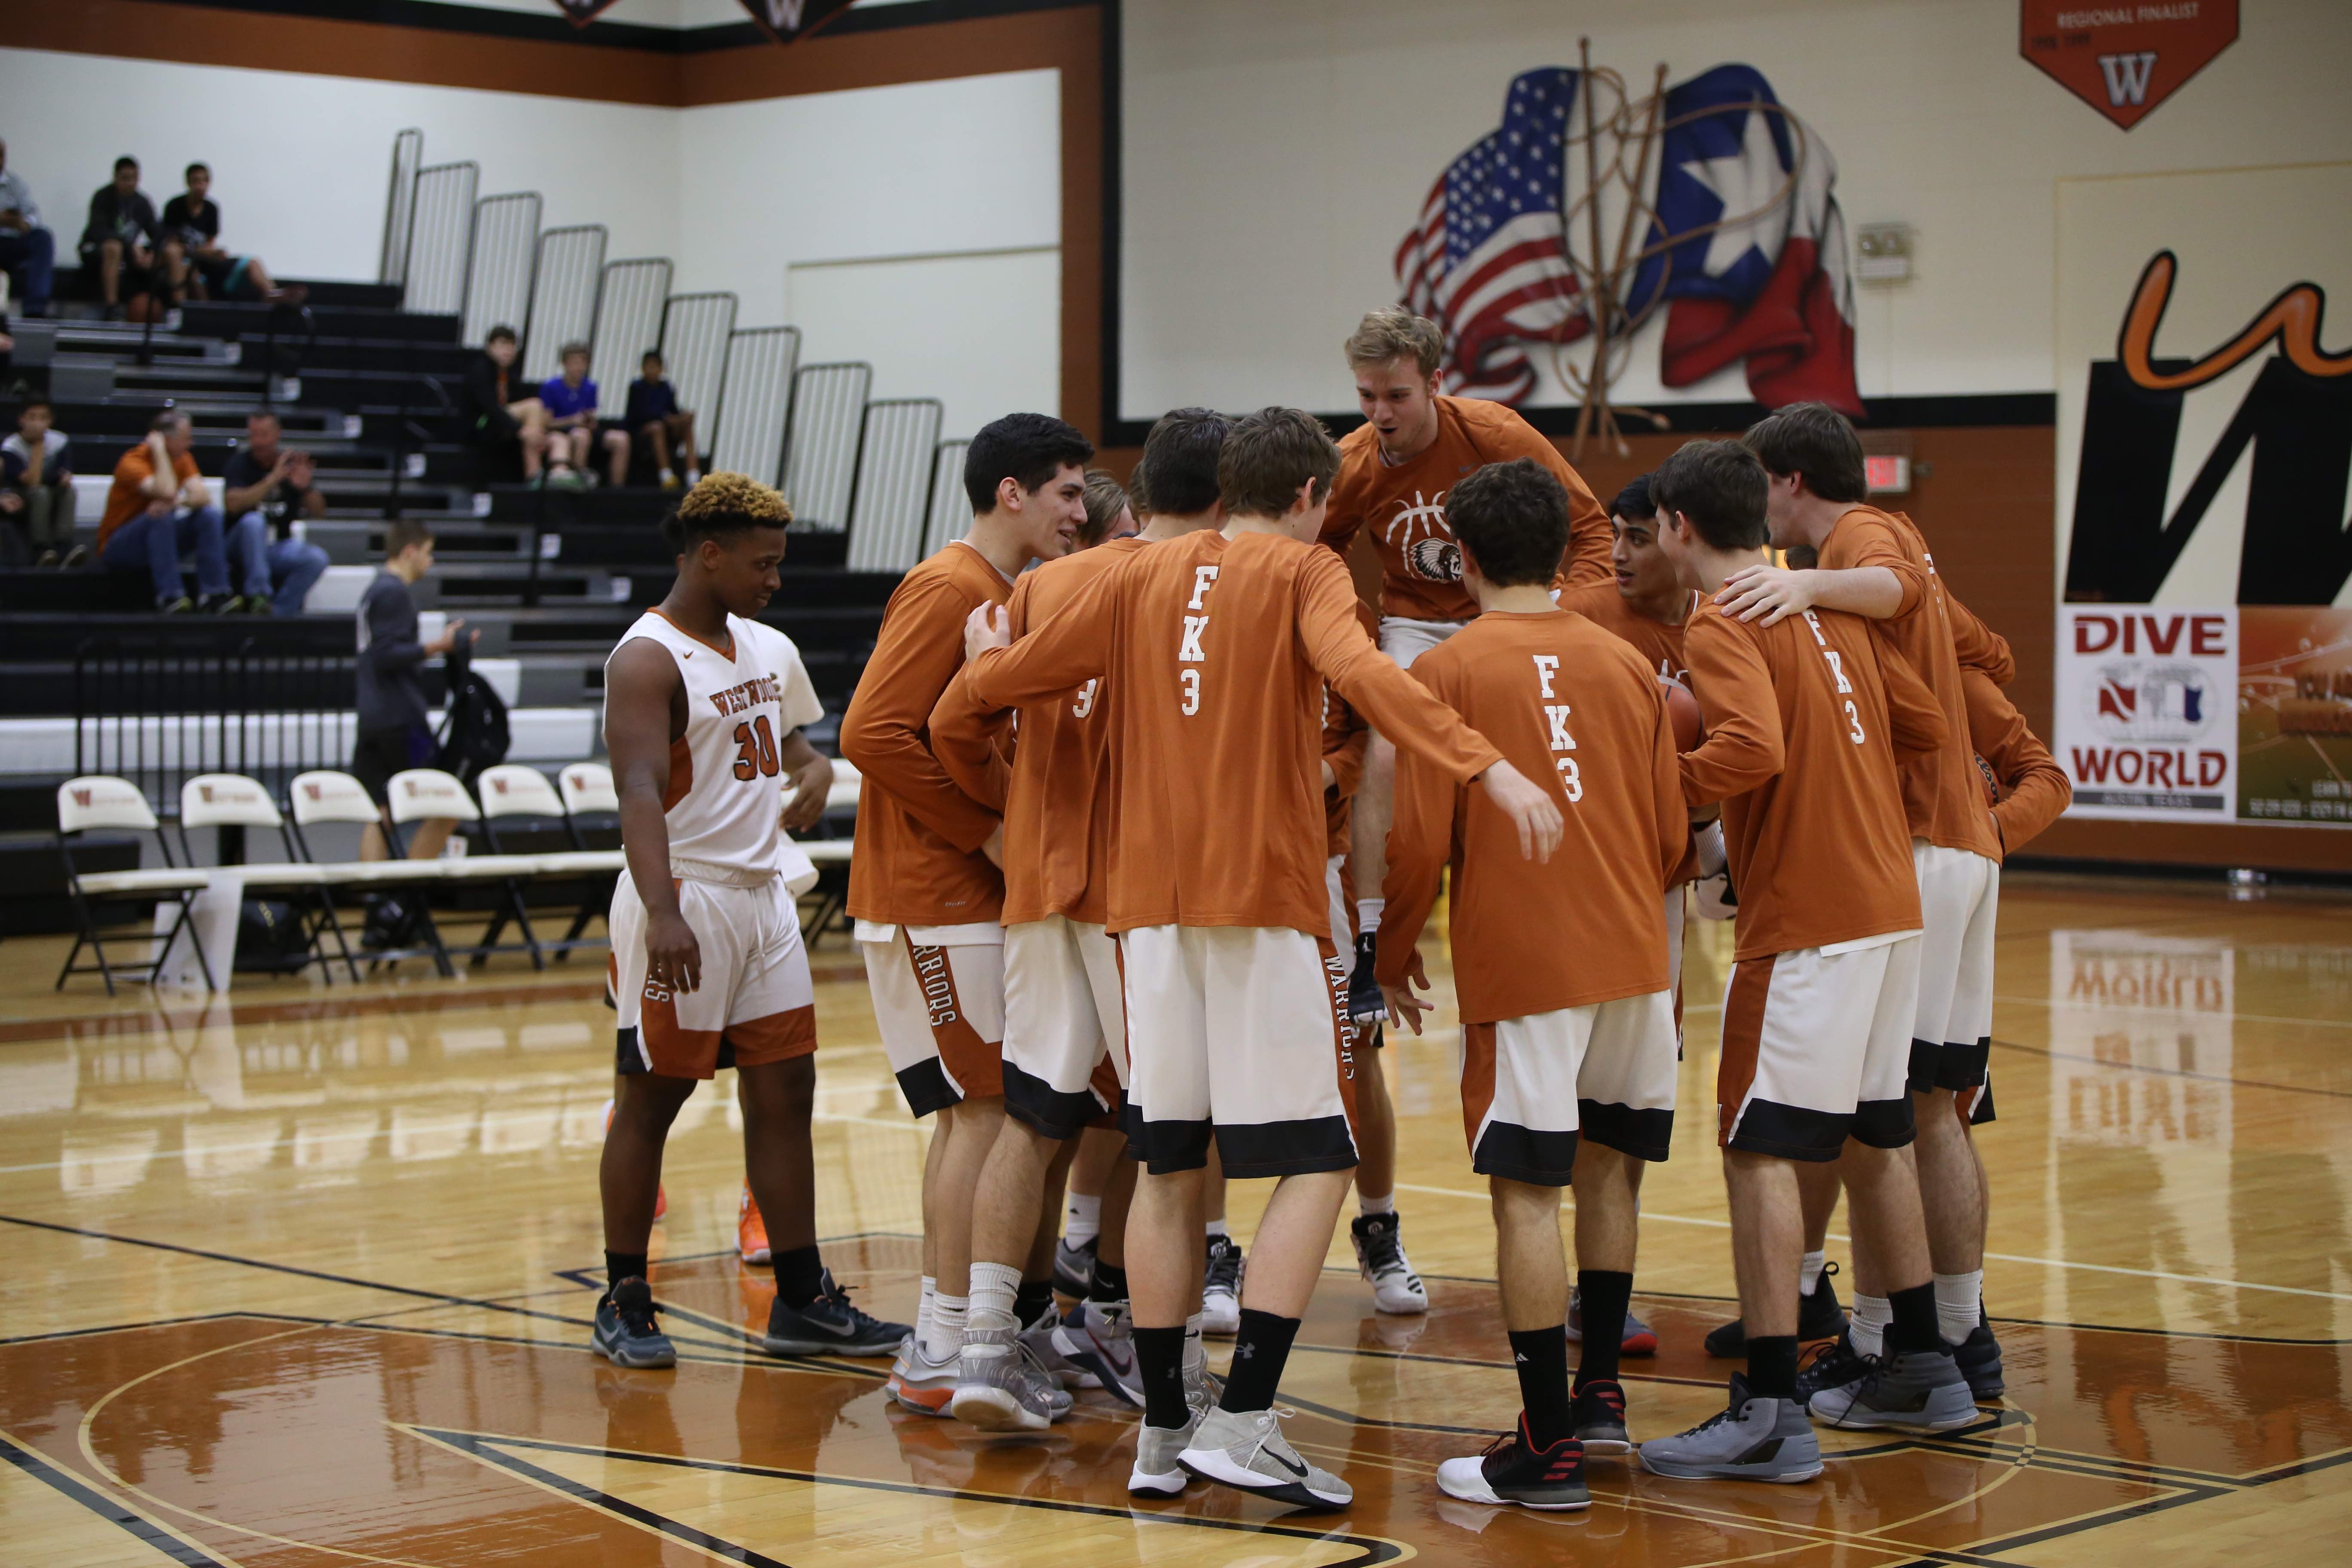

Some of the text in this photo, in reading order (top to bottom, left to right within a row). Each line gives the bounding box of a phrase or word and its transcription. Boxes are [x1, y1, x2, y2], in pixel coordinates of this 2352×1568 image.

[2057, 1, 2199, 28] REGIONAL FINALIST
[2098, 52, 2157, 107] W
[2074, 615, 2226, 655] DIVE
[733, 714, 780, 781] 30
[2071, 745, 2226, 790] WORLD
